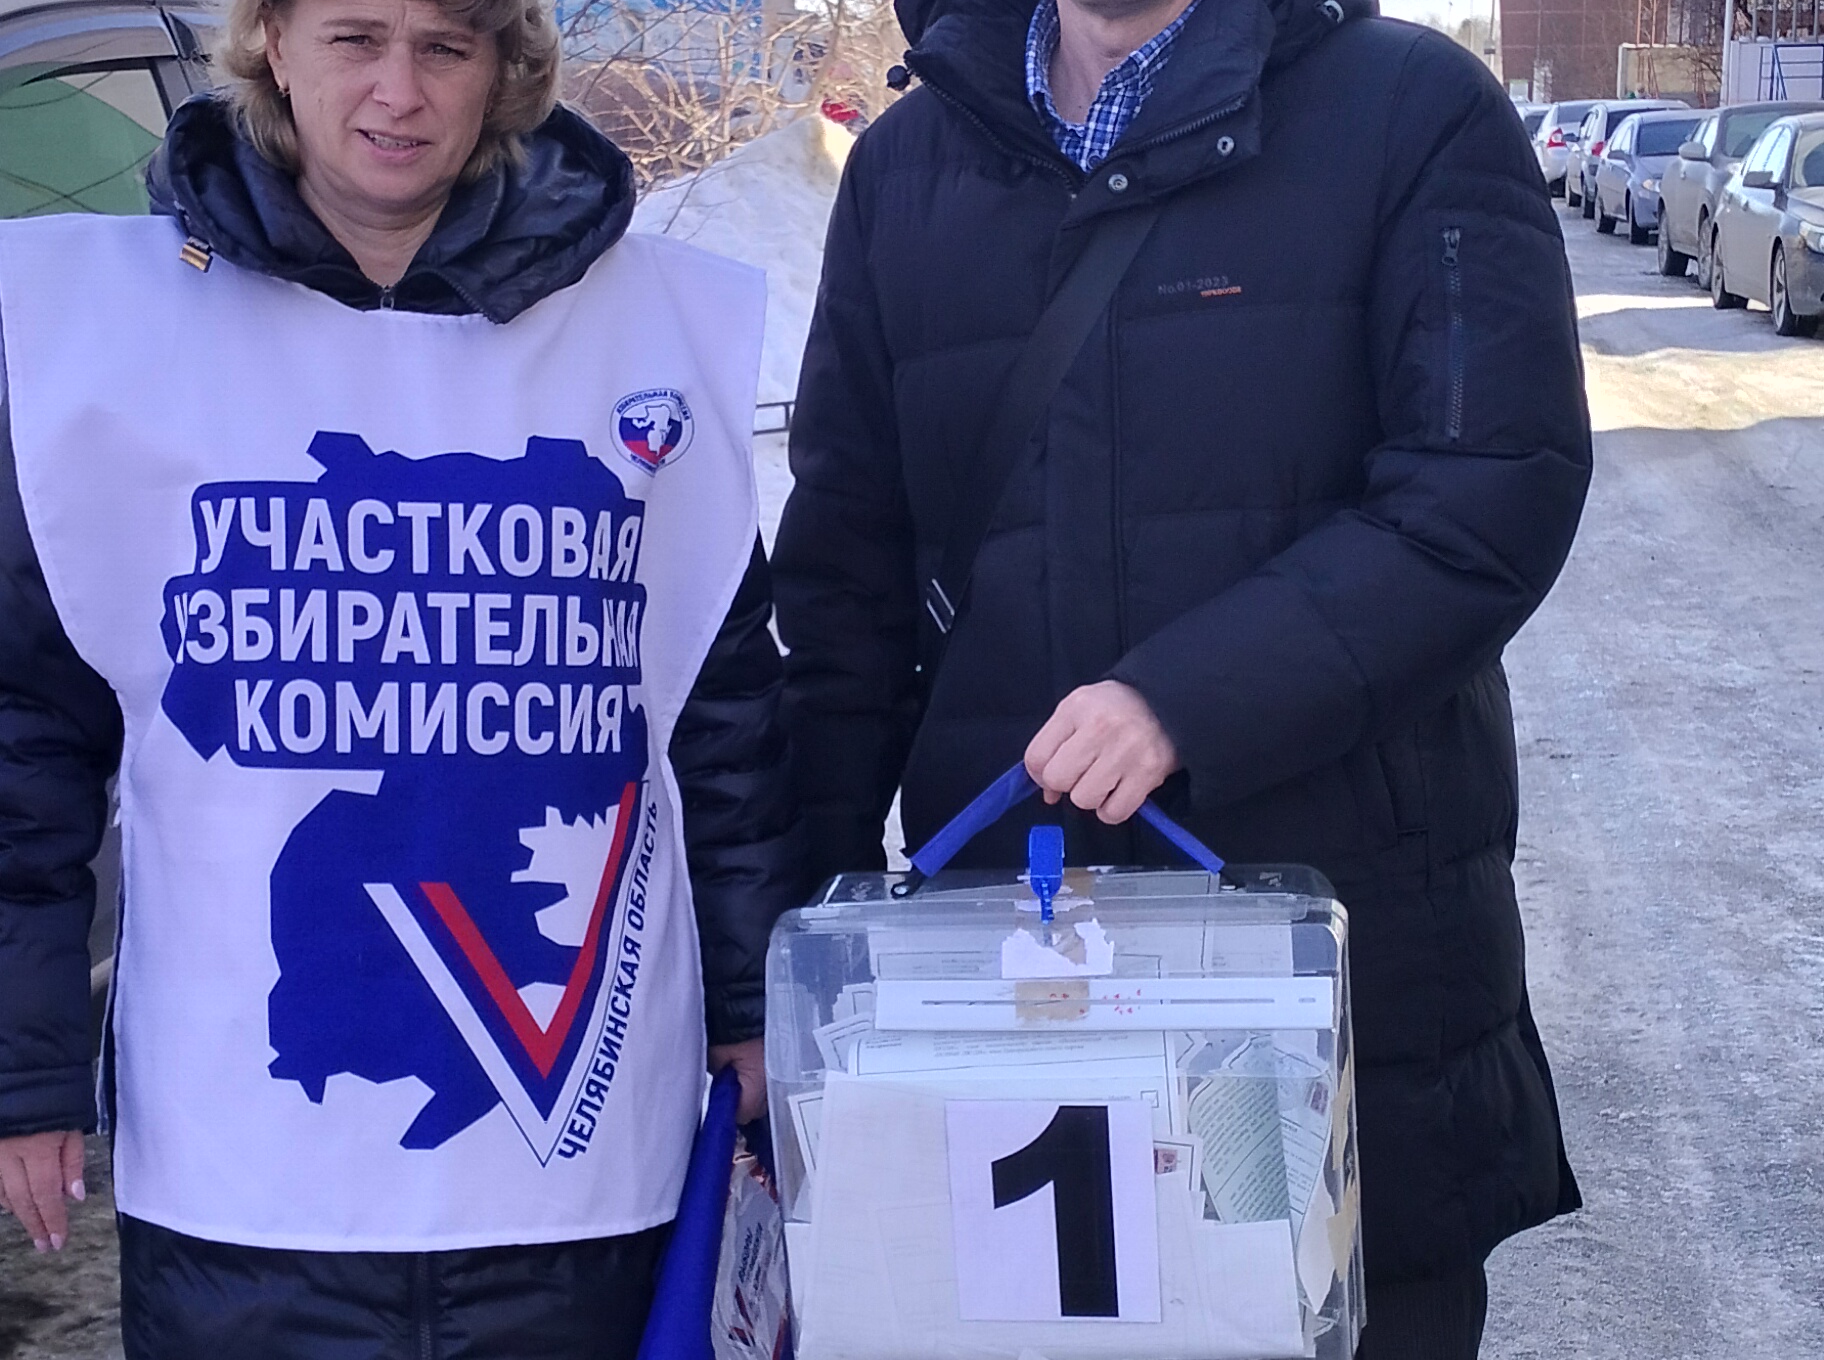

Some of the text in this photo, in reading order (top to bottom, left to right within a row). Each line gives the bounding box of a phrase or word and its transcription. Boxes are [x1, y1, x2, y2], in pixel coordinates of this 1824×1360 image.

[200, 497, 641, 583] УЧАСТКОВАЯ
[235, 679, 622, 756] КОМИССИЯ
[557, 800, 658, 1160] ЧЕЛЯБИНСКАЯ ОБЛАСТЬ
[990, 1105, 1119, 1318] 1
